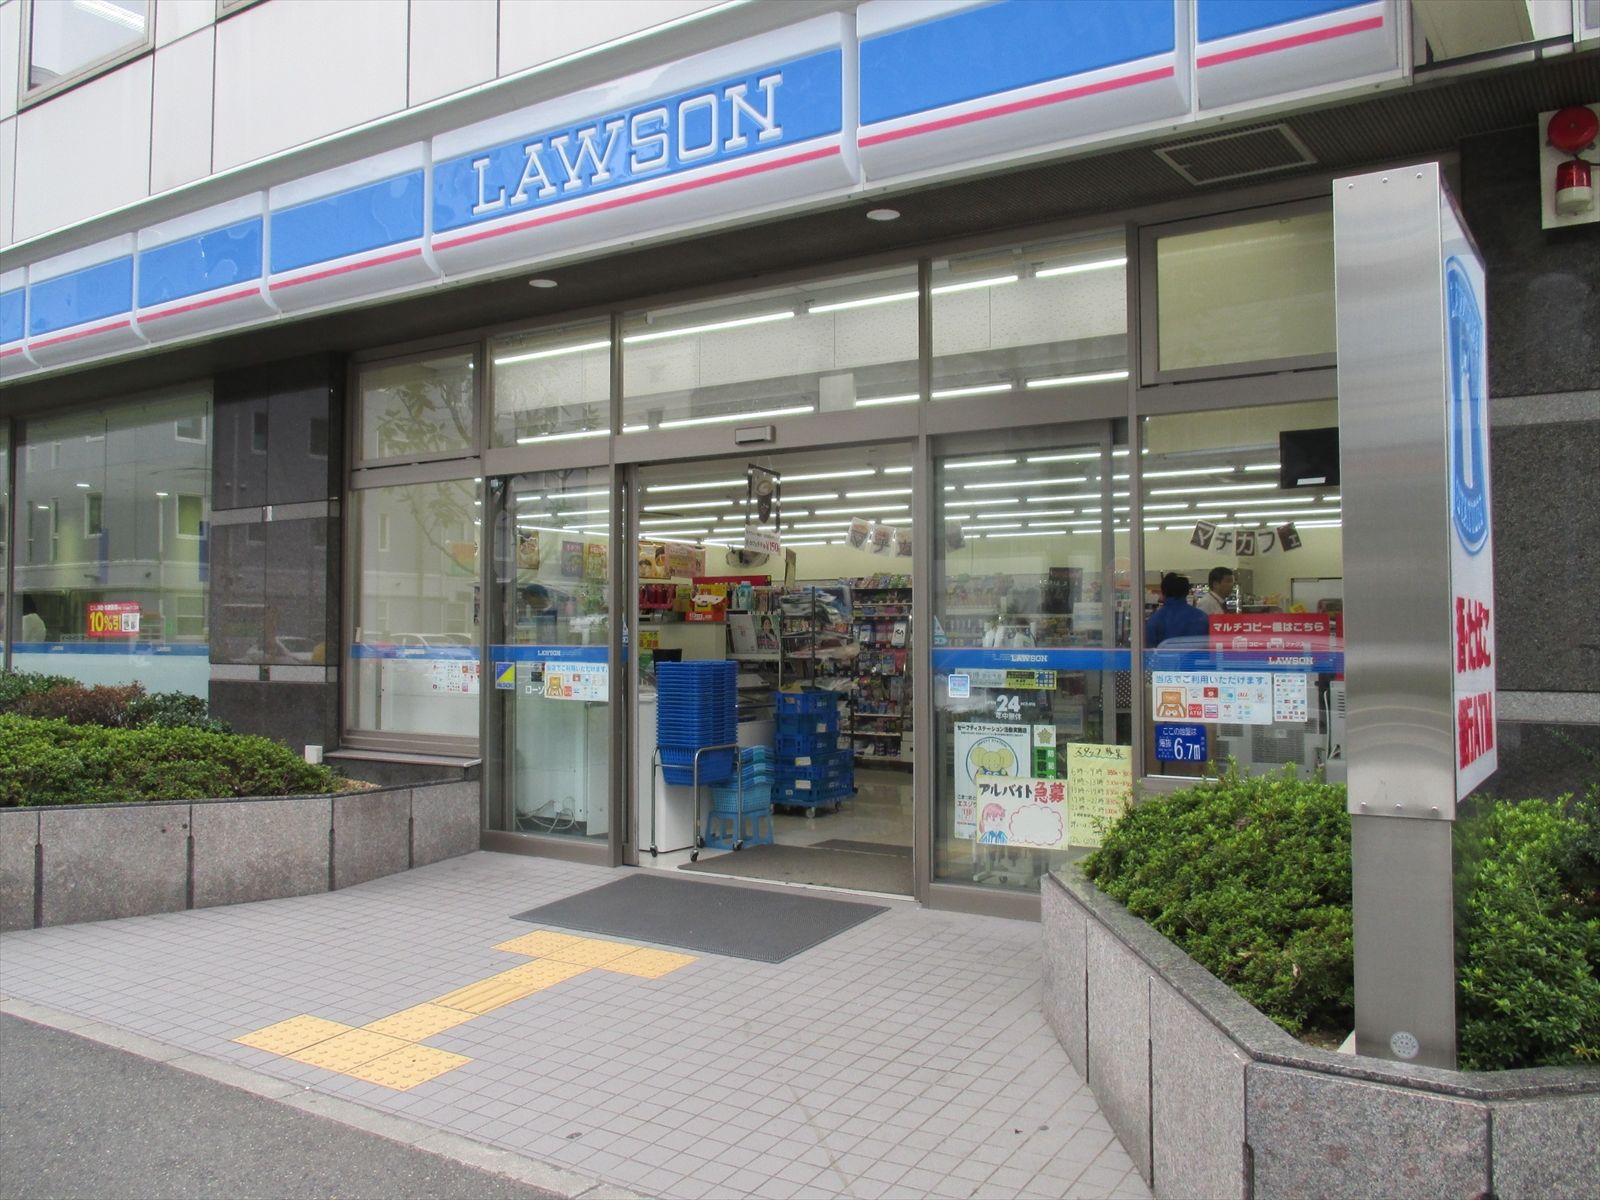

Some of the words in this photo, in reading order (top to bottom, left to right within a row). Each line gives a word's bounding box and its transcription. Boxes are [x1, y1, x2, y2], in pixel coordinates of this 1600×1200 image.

[472, 72, 783, 216] LAWSON
[1196, 522, 1301, 555] マチカフェ
[90, 611, 122, 632] 10%引
[1213, 622, 1324, 633] マルチコピー機はこちら
[1011, 654, 1048, 662] LAWSON
[1268, 656, 1314, 665] LAWSON
[1155, 674, 1269, 686] 当店でご利用いただけます。
[996, 695, 1021, 712] 24
[1174, 738, 1201, 760] 6.7m
[978, 781, 1066, 803] アルバイト急募
